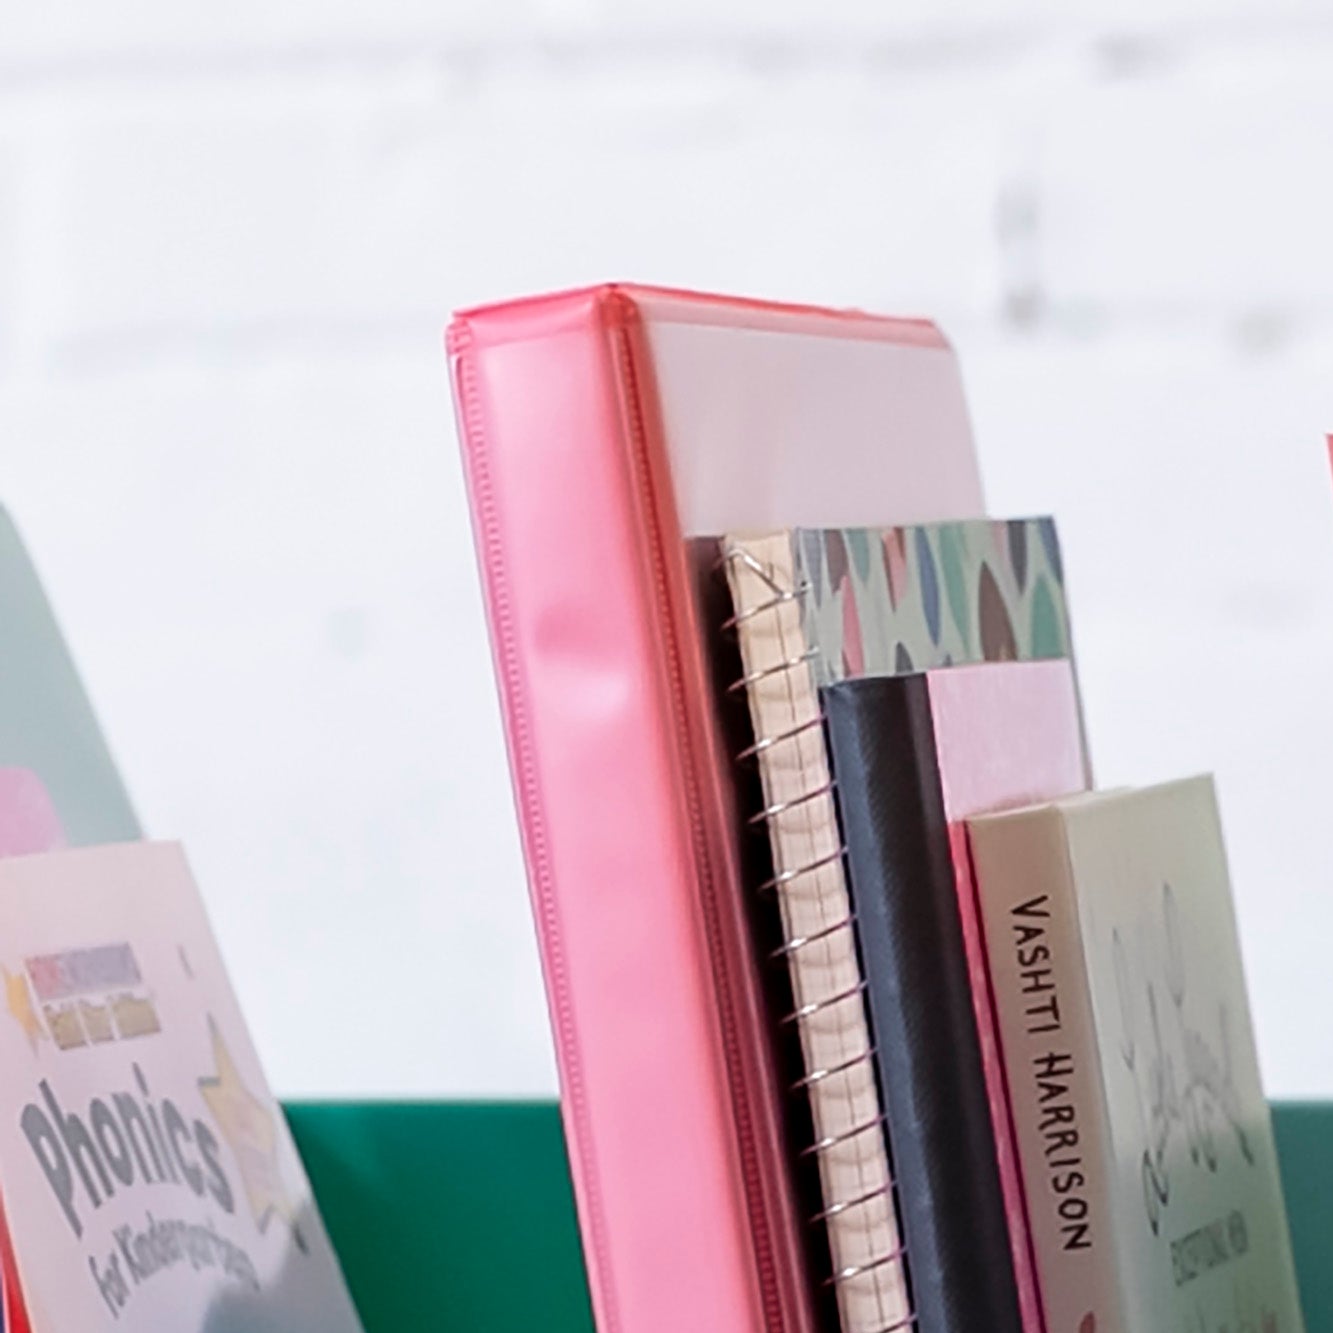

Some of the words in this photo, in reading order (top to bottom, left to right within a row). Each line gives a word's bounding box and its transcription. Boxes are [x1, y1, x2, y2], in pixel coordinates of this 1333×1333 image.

[1010, 894, 1061, 1035] VASHTI
[19, 1061, 236, 1240] Phonics
[1032, 1051, 1092, 1253] HARRISON
